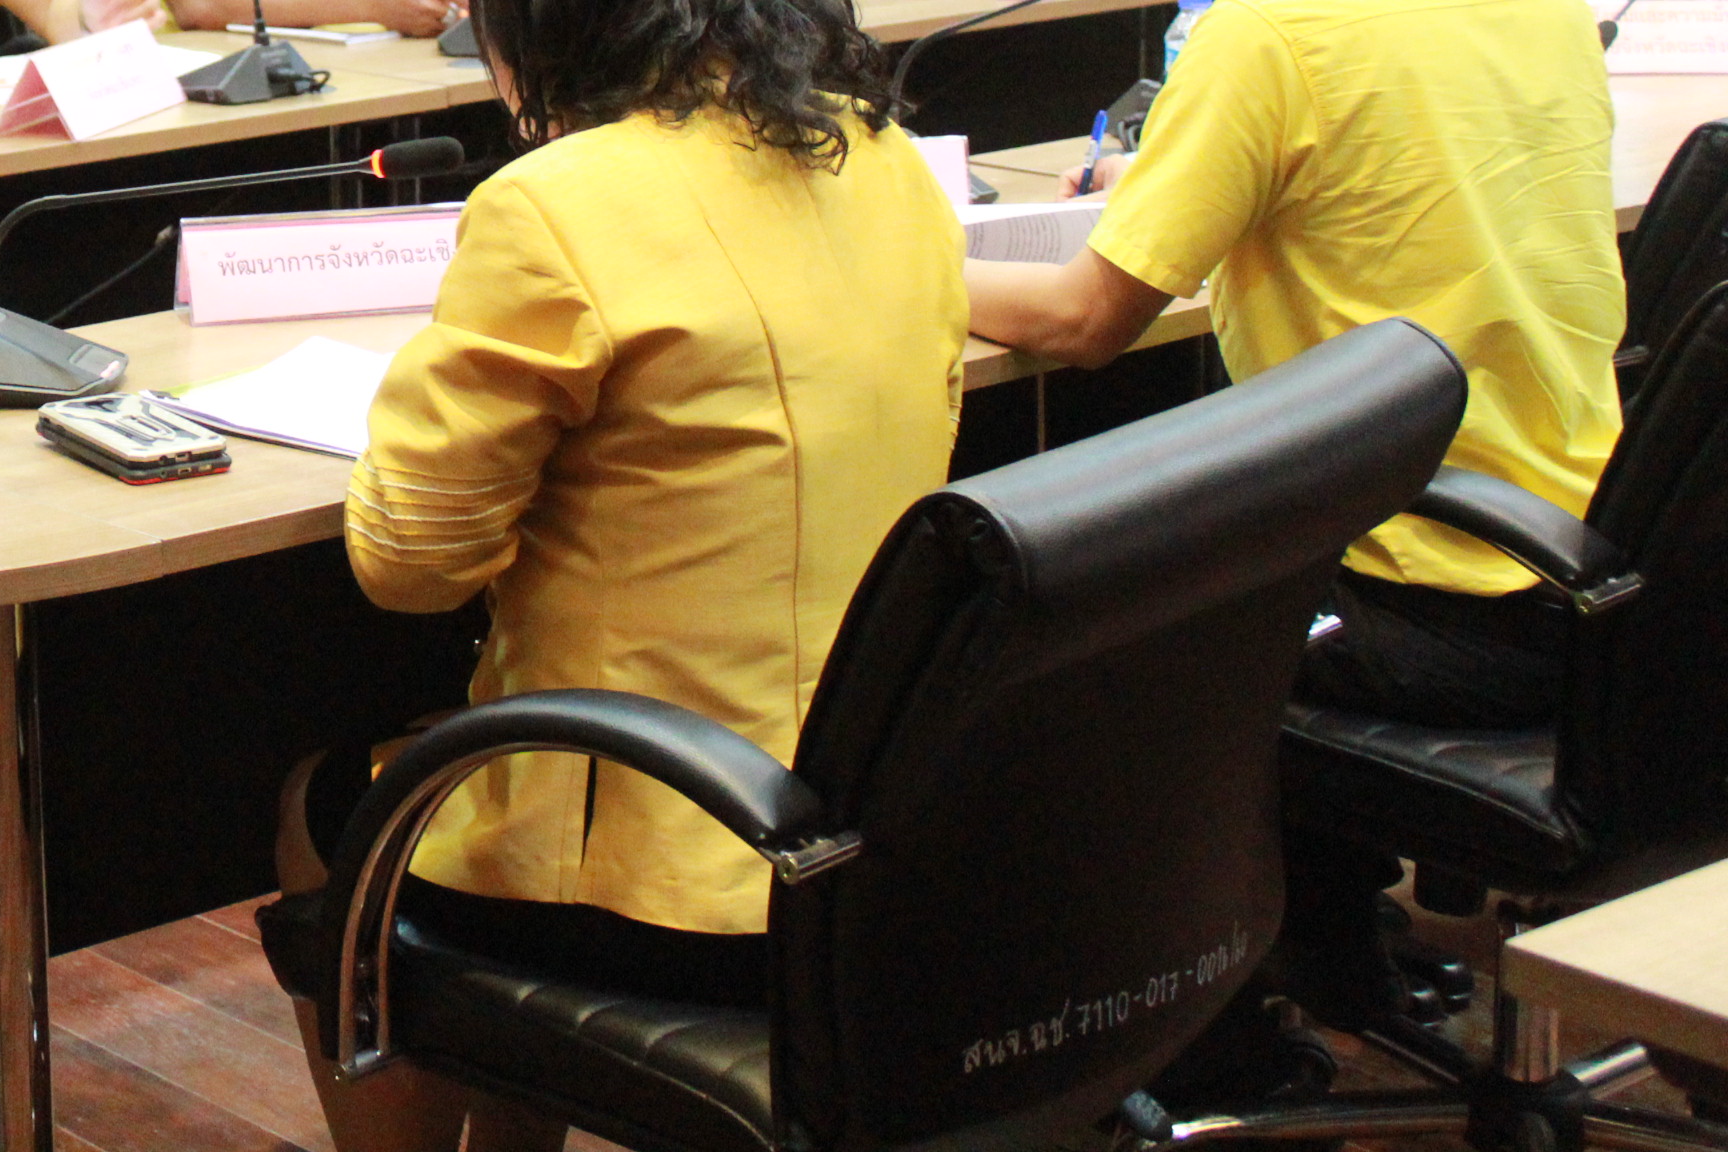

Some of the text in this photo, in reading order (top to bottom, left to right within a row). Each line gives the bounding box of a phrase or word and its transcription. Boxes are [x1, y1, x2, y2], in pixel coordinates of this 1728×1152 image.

[217, 238, 454, 278] พัฒนาการจังหวัดฉะเชิ
